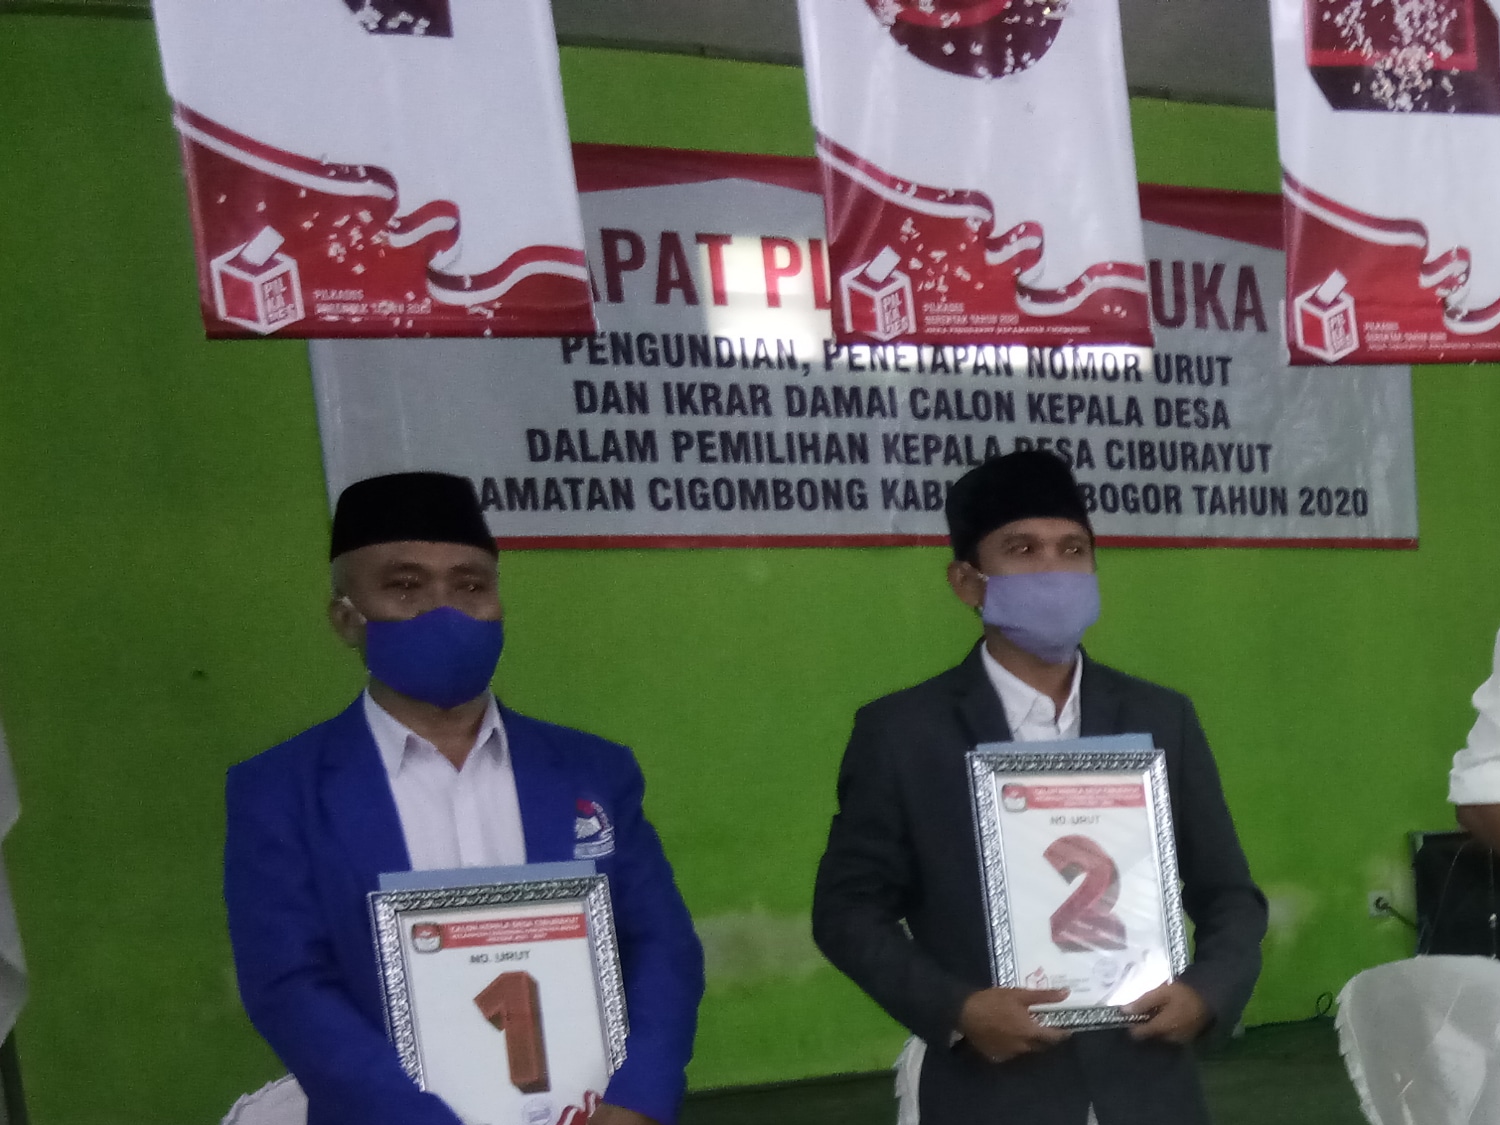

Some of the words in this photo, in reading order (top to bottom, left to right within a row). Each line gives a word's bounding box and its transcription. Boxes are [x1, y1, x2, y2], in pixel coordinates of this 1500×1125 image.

[589, 228, 732, 306] PAT
[1150, 259, 1267, 332] UKA
[561, 331, 811, 377] PENGUNDIAN,
[1027, 346, 1143, 382] NOMOR
[1154, 353, 1232, 387] URUT
[573, 380, 650, 415] DAN
[663, 381, 772, 417] IKRAR
[785, 384, 898, 419] DAMAI
[910, 387, 1015, 422] CALON
[1027, 392, 1144, 427] KEPALA
[1154, 397, 1231, 429] DESA
[527, 428, 658, 464] DALAM
[672, 430, 869, 465] PEMILIHAN
[882, 432, 1001, 466] KEPALA
[1105, 438, 1272, 474] CIBURAYUT
[480, 477, 635, 512] AMATAN
[650, 477, 868, 512] CIGOMBONG
[1192, 484, 1288, 517] TAHUN
[1299, 486, 1369, 517] 2020
[1043, 834, 1127, 952] 2
[474, 971, 550, 1094] 1
